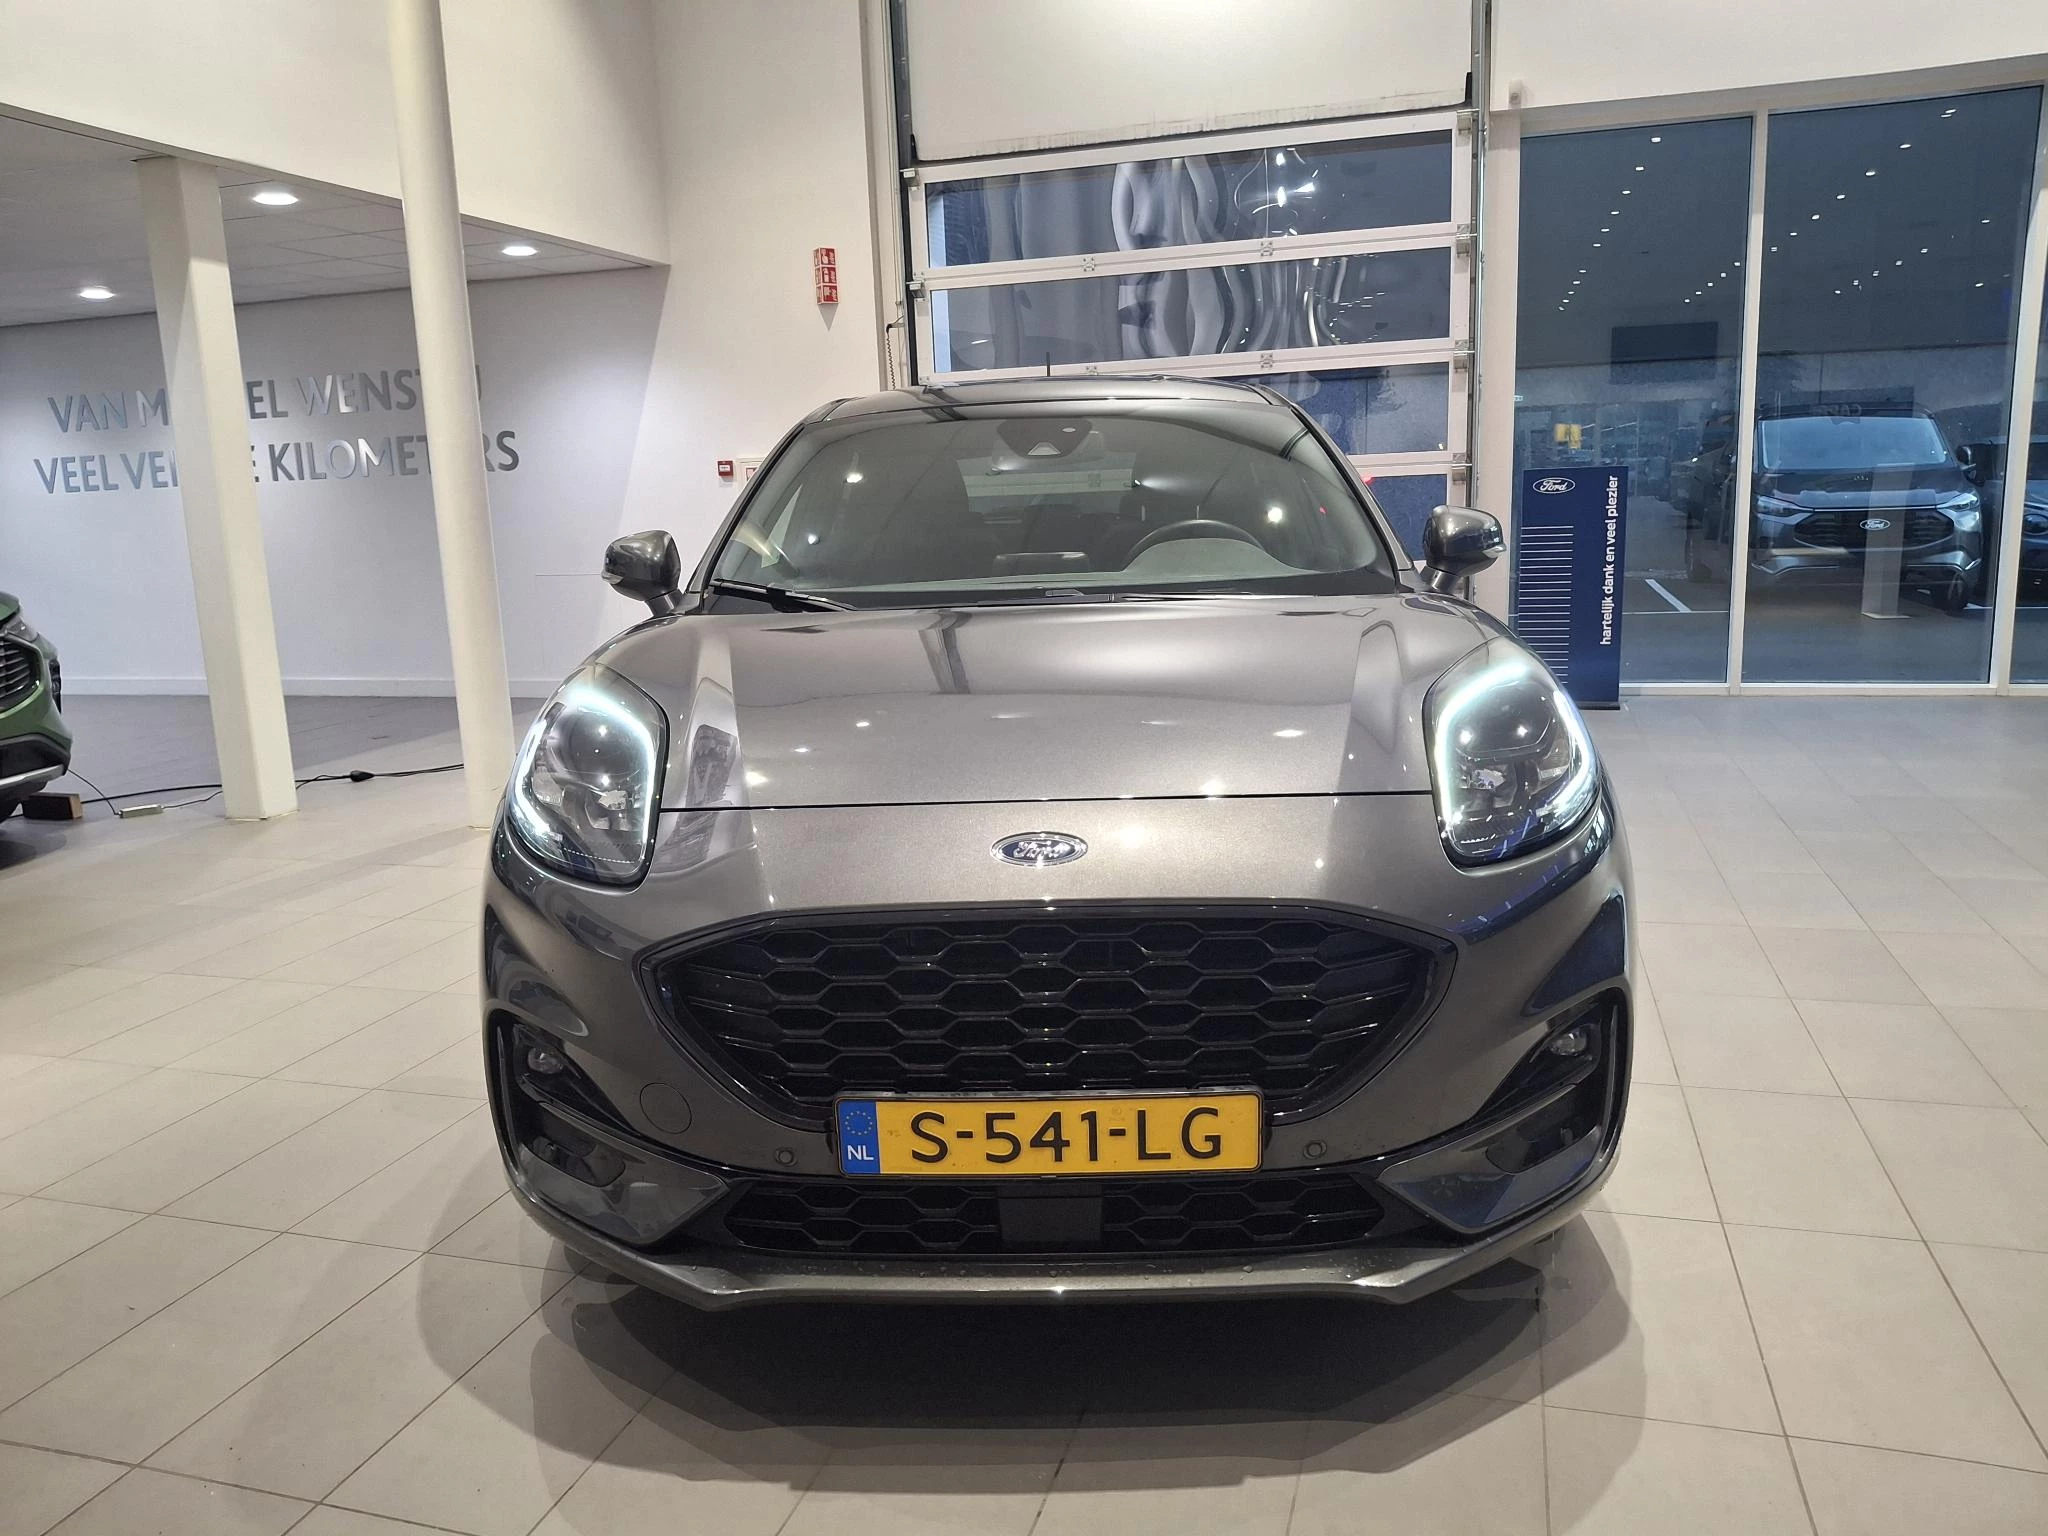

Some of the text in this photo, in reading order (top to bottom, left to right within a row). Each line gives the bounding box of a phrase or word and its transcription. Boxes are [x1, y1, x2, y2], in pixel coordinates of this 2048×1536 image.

[47, 391, 128, 432] VAN
[135, 379, 288, 427] MEL
[299, 367, 420, 416] WENS
[34, 455, 119, 494] VEEL
[1537, 477, 1570, 493] Ford
[1600, 475, 1619, 645] hartelijk dank en veel plezier
[847, 1144, 874, 1161] NL
[910, 1106, 1221, 1164] S-541-LG
